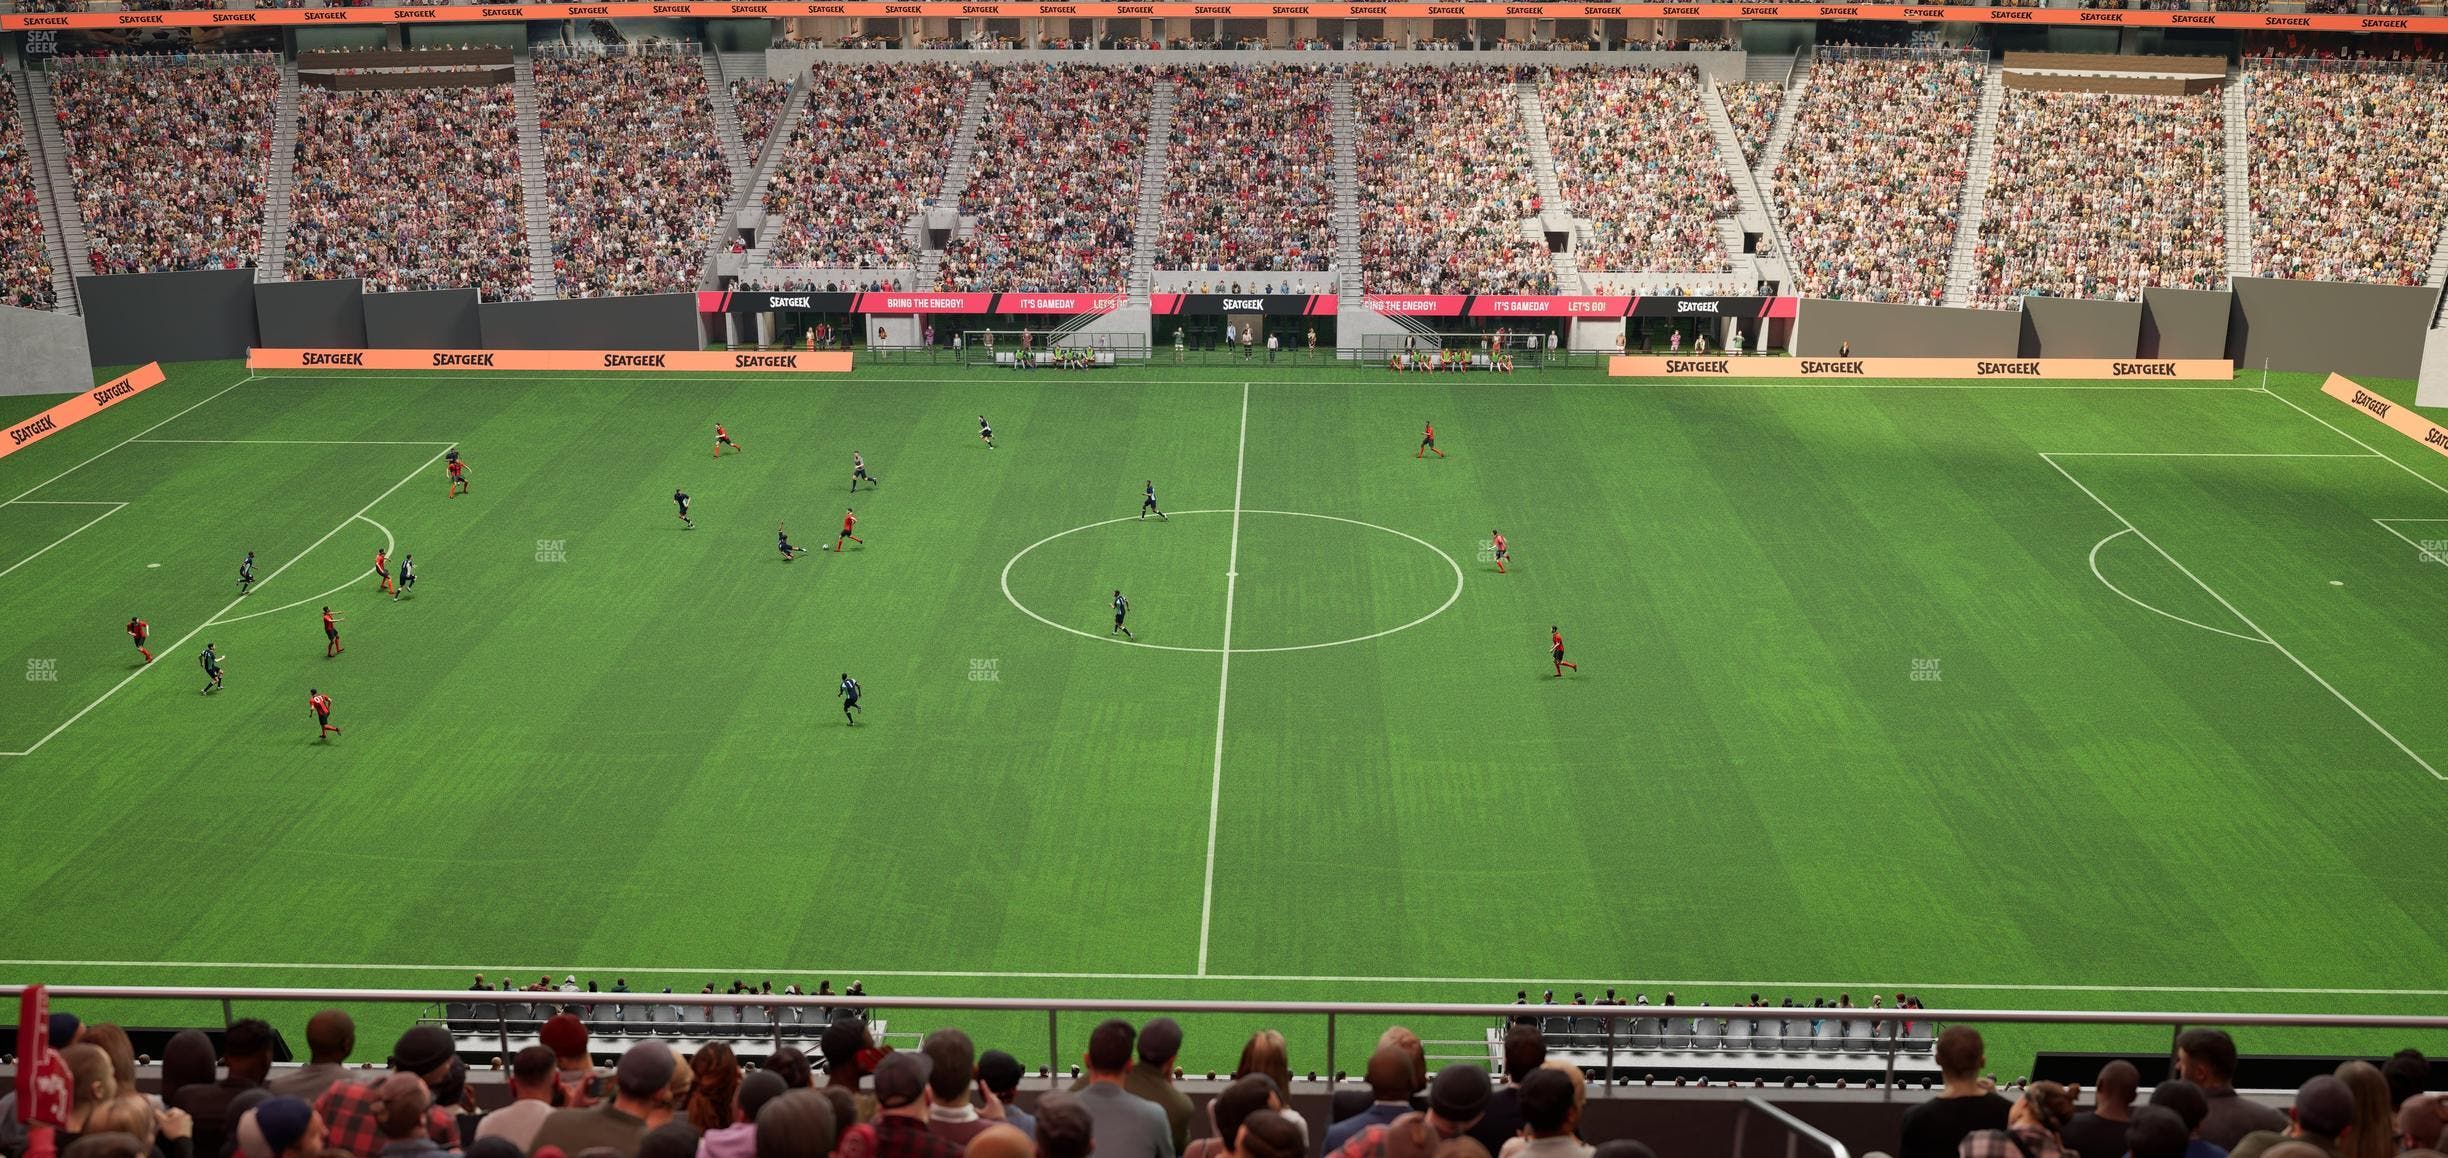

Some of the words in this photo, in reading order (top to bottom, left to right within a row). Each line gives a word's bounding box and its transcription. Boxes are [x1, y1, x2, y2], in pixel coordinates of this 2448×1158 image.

[24, 17, 68, 25] SEATGEEK
[119, 15, 163, 24] SEATGEEK
[213, 14, 256, 22] SEATGEEK
[305, 12, 347, 20] SEATGEEK
[395, 10, 435, 18] SEATGEEK
[482, 8, 523, 16] SEATGEEK
[569, 7, 608, 15] SEATGEEK
[653, 5, 690, 13] SEATGEEK
[732, 5, 767, 13] SEATGEEK
[1118, 6, 1153, 14] SEATGEEK
[1663, 7, 1699, 15] SEATGEEK
[1742, 7, 1778, 15] SEATGEEK
[1820, 7, 1857, 15] SEATGEEK
[1991, 11, 2032, 19] SEATGEEK
[2080, 13, 2123, 21] SEATGEEK
[2172, 15, 2215, 24] SEATGEEK
[2266, 17, 2310, 26] SEATGEEK
[2362, 19, 2407, 28] SEATGEEK
[770, 297, 811, 308] SEATGEEK
[887, 299, 913, 308] BRING
[914, 299, 929, 308] THE
[930, 299, 964, 308] ENERGY!
[1020, 299, 1036, 308] IT'S
[1037, 299, 1075, 308] GAMEDAY
[1223, 299, 1264, 310] SEATGEEK
[1386, 302, 1401, 311] THE
[1402, 302, 1437, 311] ENERGY!
[1494, 302, 1510, 311] IT'S
[1511, 302, 1549, 312] GAMEDAY
[1568, 302, 1590, 312] LET'S
[1591, 302, 1606, 312] GO!
[1678, 301, 1719, 312] SEATGEEK
[302, 352, 363, 366] SEATGEEK
[432, 353, 493, 366] SEATGEEK
[603, 354, 665, 367] SEATGEEK
[735, 355, 796, 368] SEATGEEK
[1666, 360, 1729, 374] SEATGEEK
[1800, 361, 1863, 375] SEATGEEK
[1977, 362, 2041, 376] SEATGEEK
[2112, 363, 2176, 377] SEATGEEK
[2351, 390, 2391, 419] SEATGEEK
[10, 415, 56, 445] SEATGEEK
[93, 378, 134, 406] SEATGEEK
